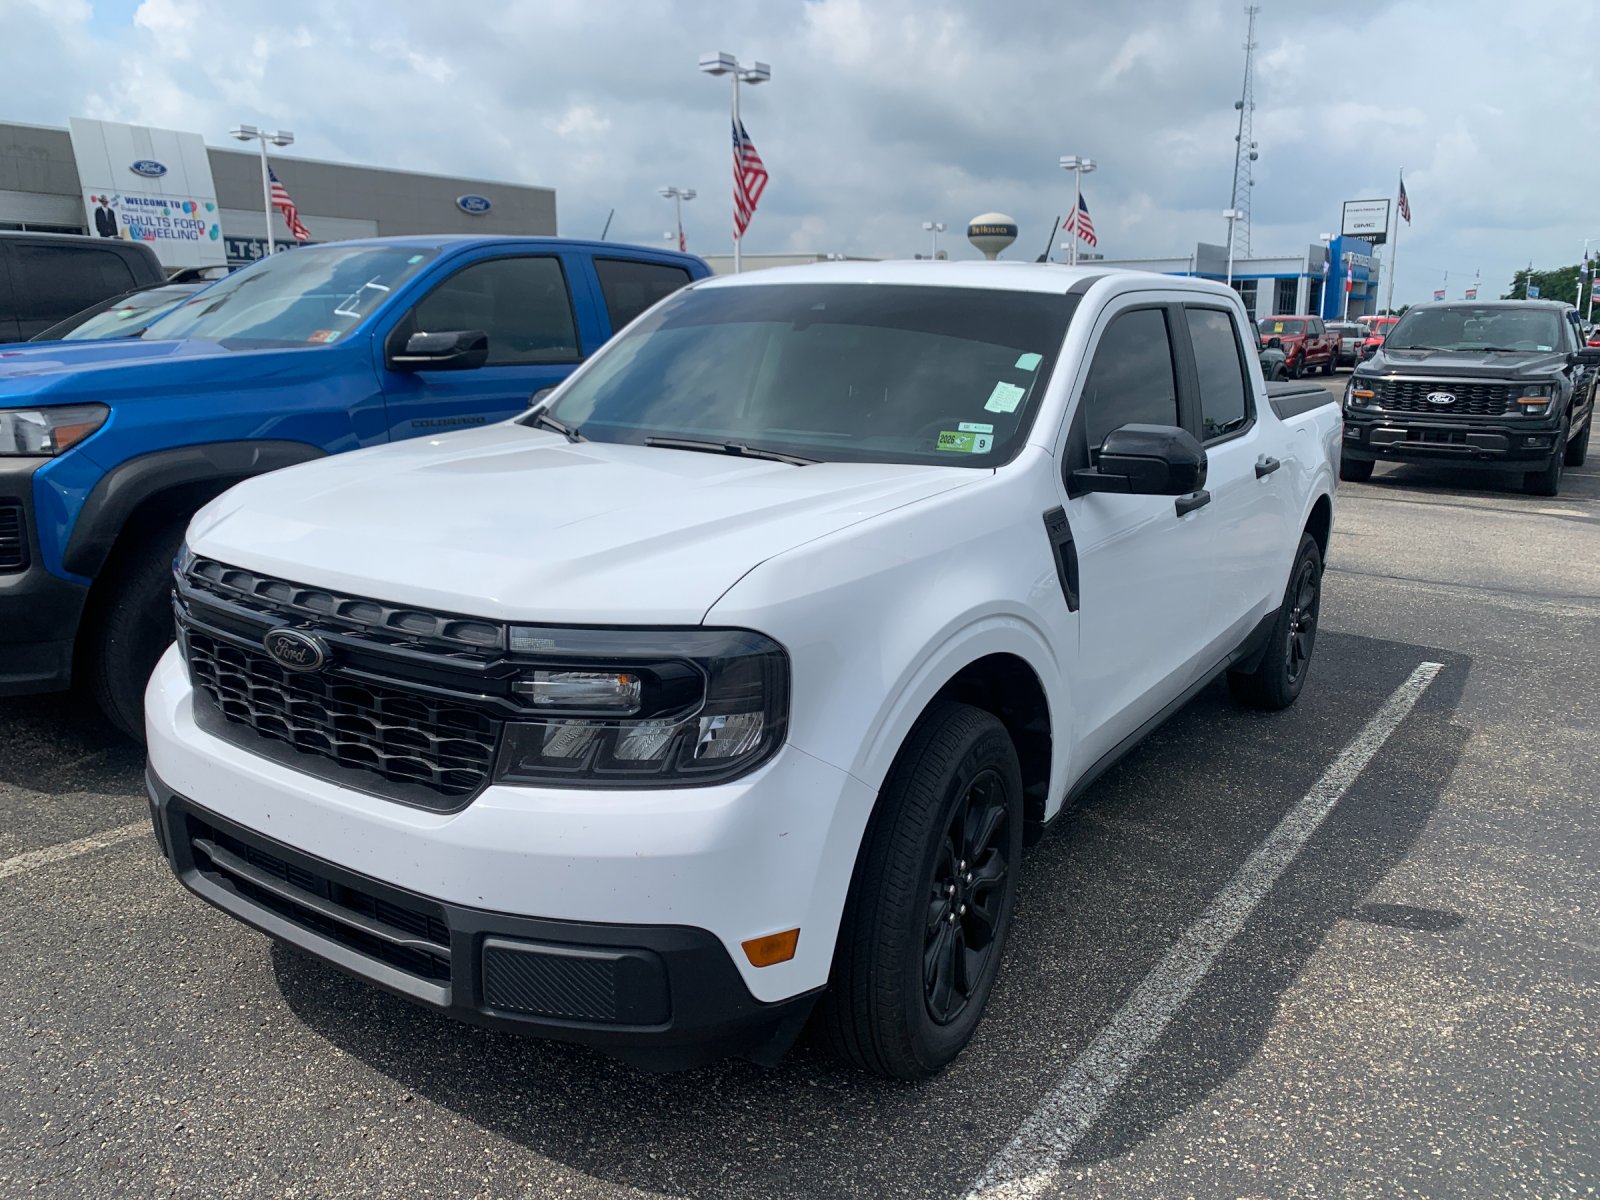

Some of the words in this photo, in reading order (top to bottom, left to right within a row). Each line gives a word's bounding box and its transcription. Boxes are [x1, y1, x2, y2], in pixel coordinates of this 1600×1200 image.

[124, 196, 168, 208] WELCOME
[170, 199, 181, 209] TO
[121, 214, 171, 228] SHULTS
[173, 219, 206, 230] FORD
[134, 227, 199, 241] WHEELING
[411, 416, 485, 427] COLORADO
[940, 434, 956, 444] 2026
[979, 439, 986, 448] 9
[274, 636, 306, 663] Ford
